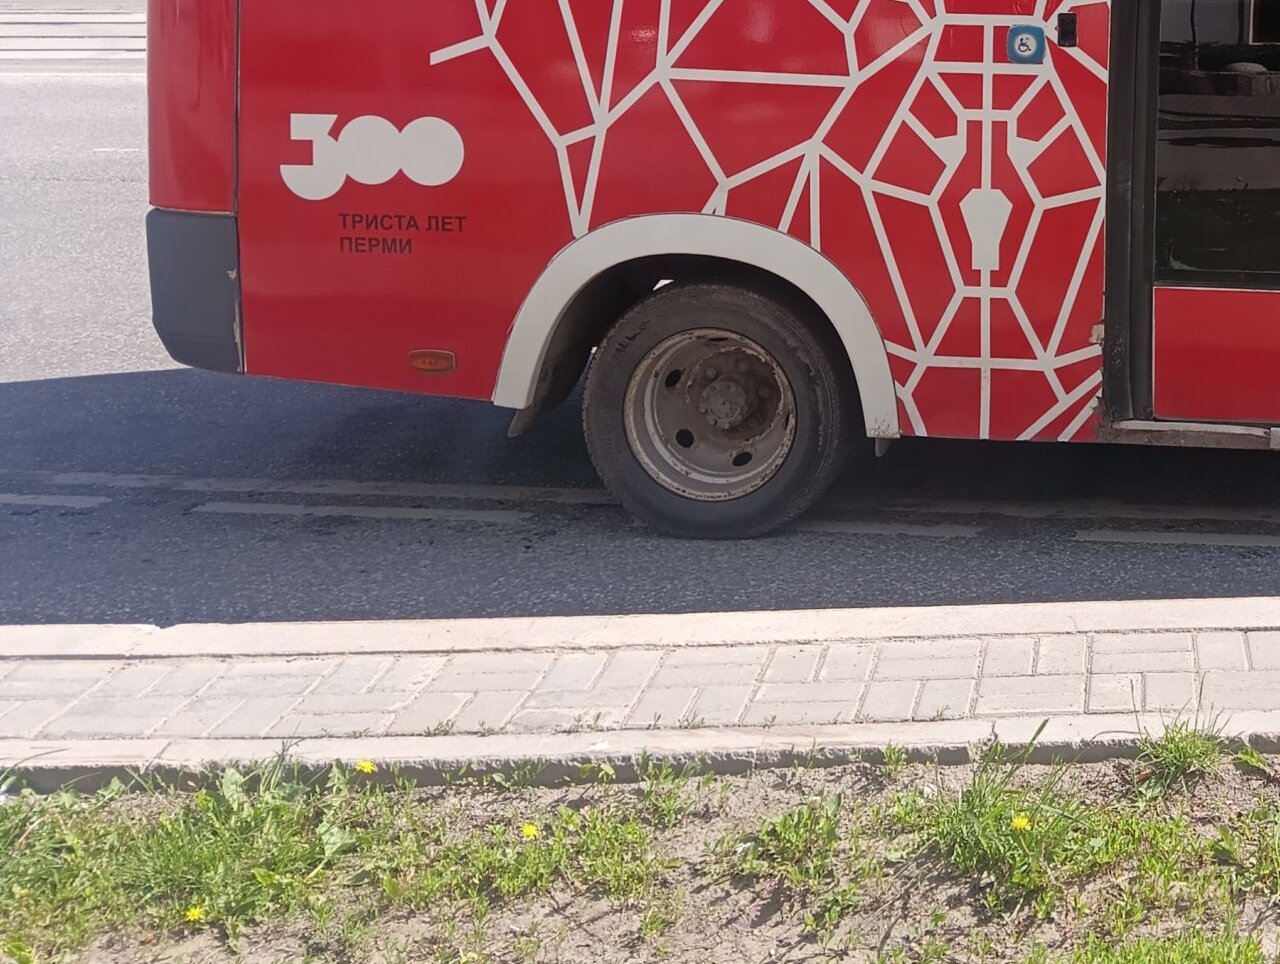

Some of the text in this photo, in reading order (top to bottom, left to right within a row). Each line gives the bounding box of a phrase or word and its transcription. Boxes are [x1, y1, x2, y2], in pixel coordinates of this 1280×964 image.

[279, 113, 465, 201] 300
[338, 213, 467, 232] ТРИСТА ЛЕТ
[340, 237, 413, 254] ПЕРМИ
